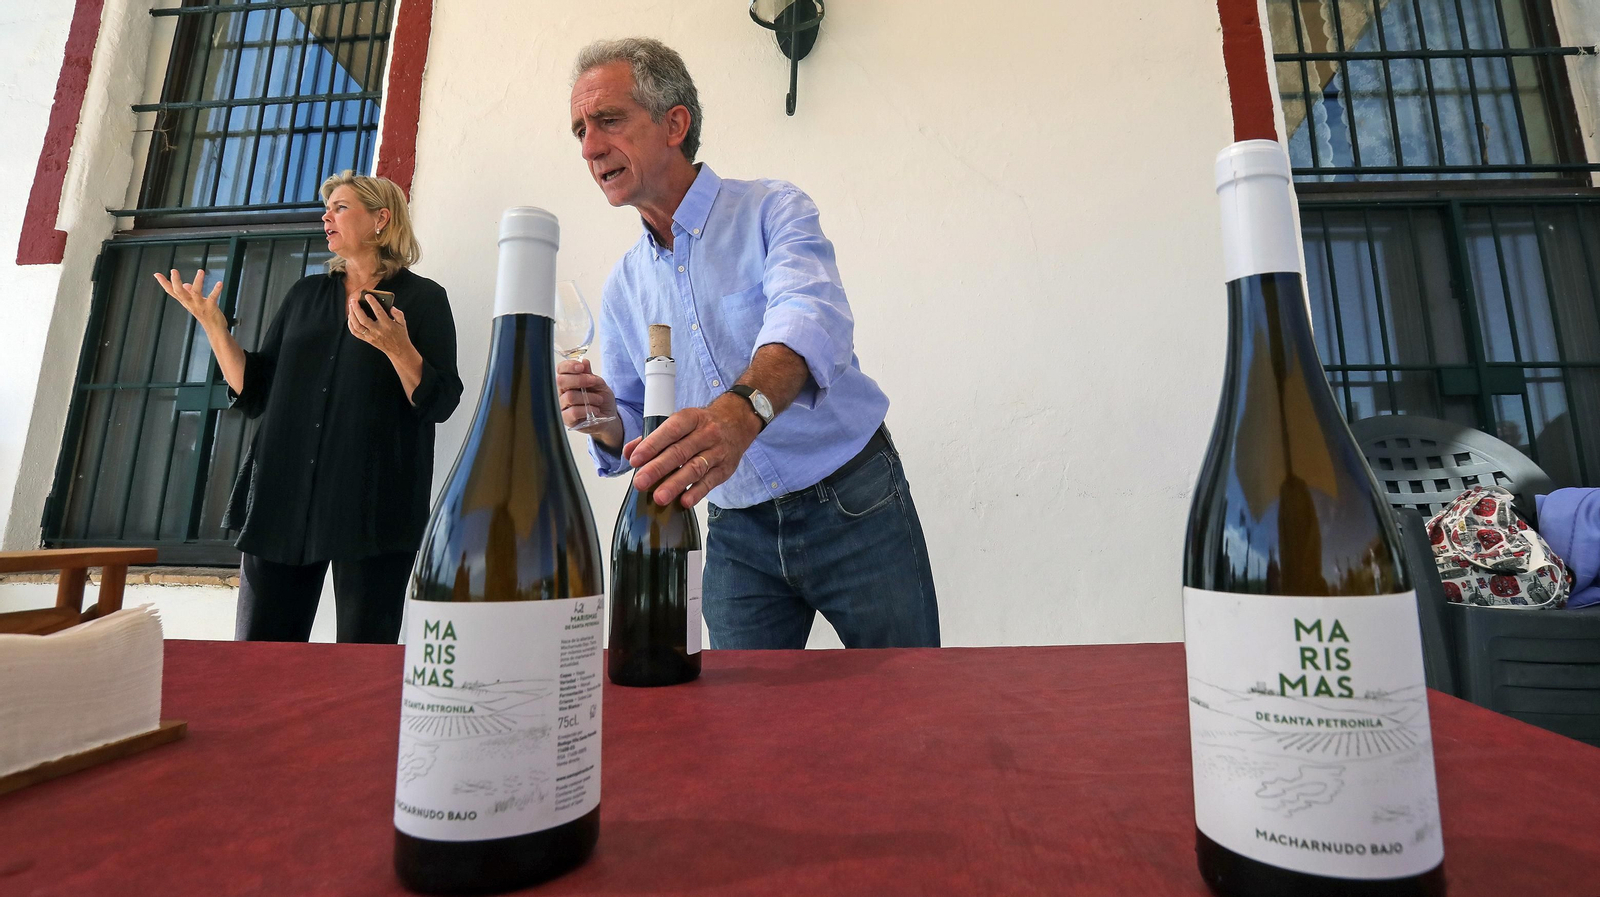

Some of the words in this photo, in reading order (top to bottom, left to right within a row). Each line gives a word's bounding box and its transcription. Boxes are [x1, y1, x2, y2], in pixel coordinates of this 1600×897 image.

[424, 619, 457, 641] MA
[1294, 617, 1350, 643] MA
[424, 643, 456, 665] RIS
[1299, 646, 1351, 671] RIS
[412, 664, 454, 688] MAS
[1279, 672, 1354, 699] MAS
[426, 704, 475, 714] PETRONILA
[1255, 711, 1271, 722] DE
[1273, 714, 1315, 727] SANTA
[1317, 718, 1384, 729] PETRONILA
[447, 810, 478, 821] BAJO
[1255, 828, 1367, 856] MACHARNUDO
[1370, 842, 1404, 855] BAJO
